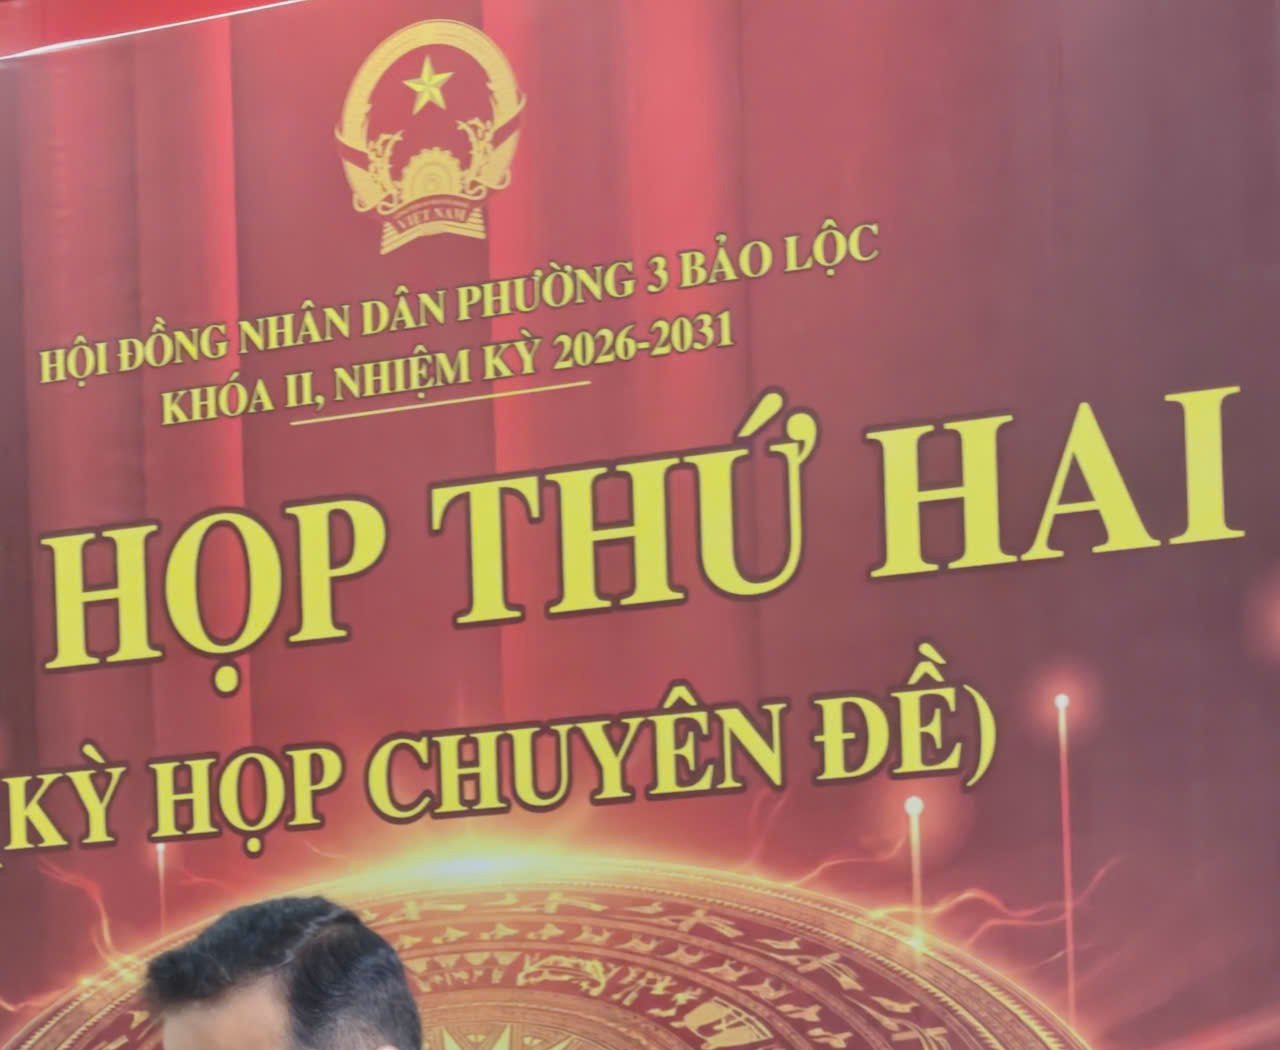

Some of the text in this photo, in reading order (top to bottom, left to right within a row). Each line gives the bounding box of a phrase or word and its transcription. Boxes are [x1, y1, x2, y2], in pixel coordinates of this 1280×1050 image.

[39, 218, 880, 387] HỘI ĐỒNG NHÂN DÂN PHƯỜNG 3 BẢO LỘC
[161, 310, 735, 426] KHÓA II, NHIỆM KỲ 2026-2031
[40, 499, 388, 694] HỌP
[429, 392, 819, 626] THỨ
[865, 385, 1246, 579] HAI
[148, 747, 342, 853] HỌP
[367, 685, 787, 820] CHUYÊN
[813, 642, 997, 787] ĐỀ)
